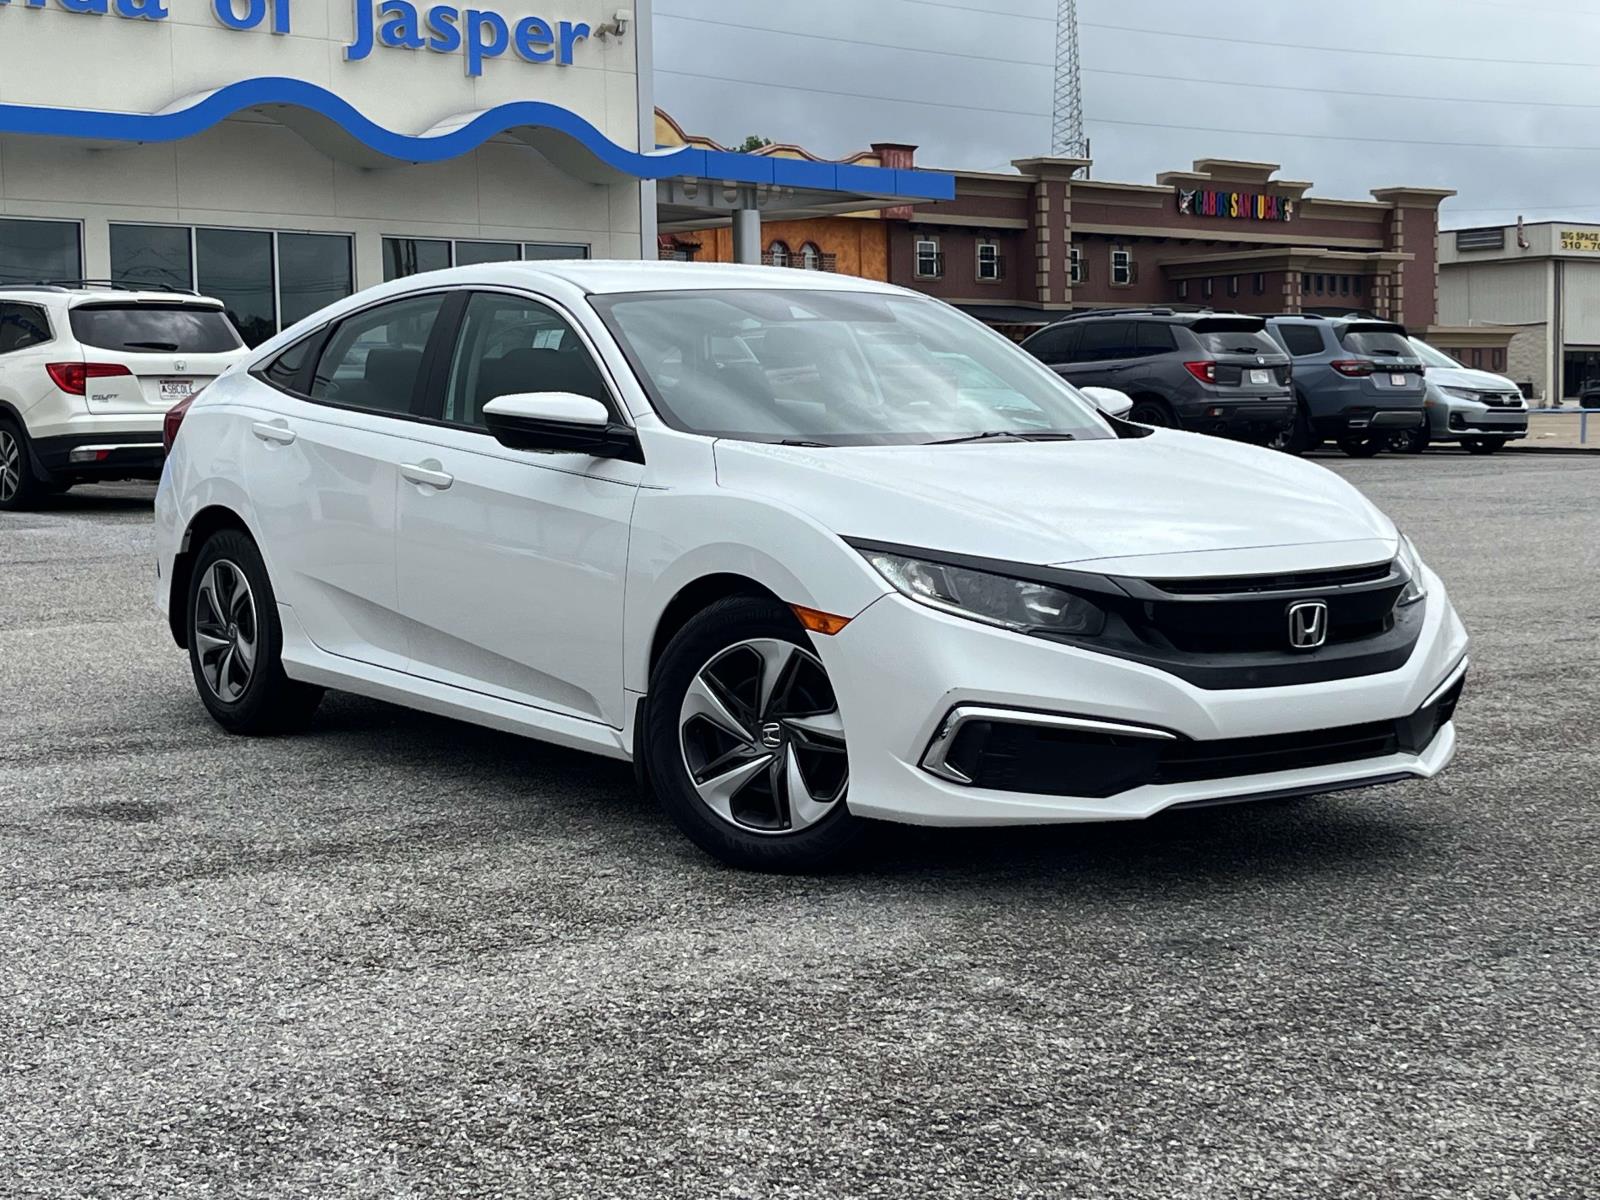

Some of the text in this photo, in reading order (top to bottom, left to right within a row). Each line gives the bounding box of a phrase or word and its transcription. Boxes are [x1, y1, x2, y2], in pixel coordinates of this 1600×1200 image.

[344, 0, 591, 77] Jasper
[1195, 190, 1283, 220] CABOS SAN LUCAS
[1561, 240, 1581, 249] 310
[1576, 231, 1599, 241] SPACE
